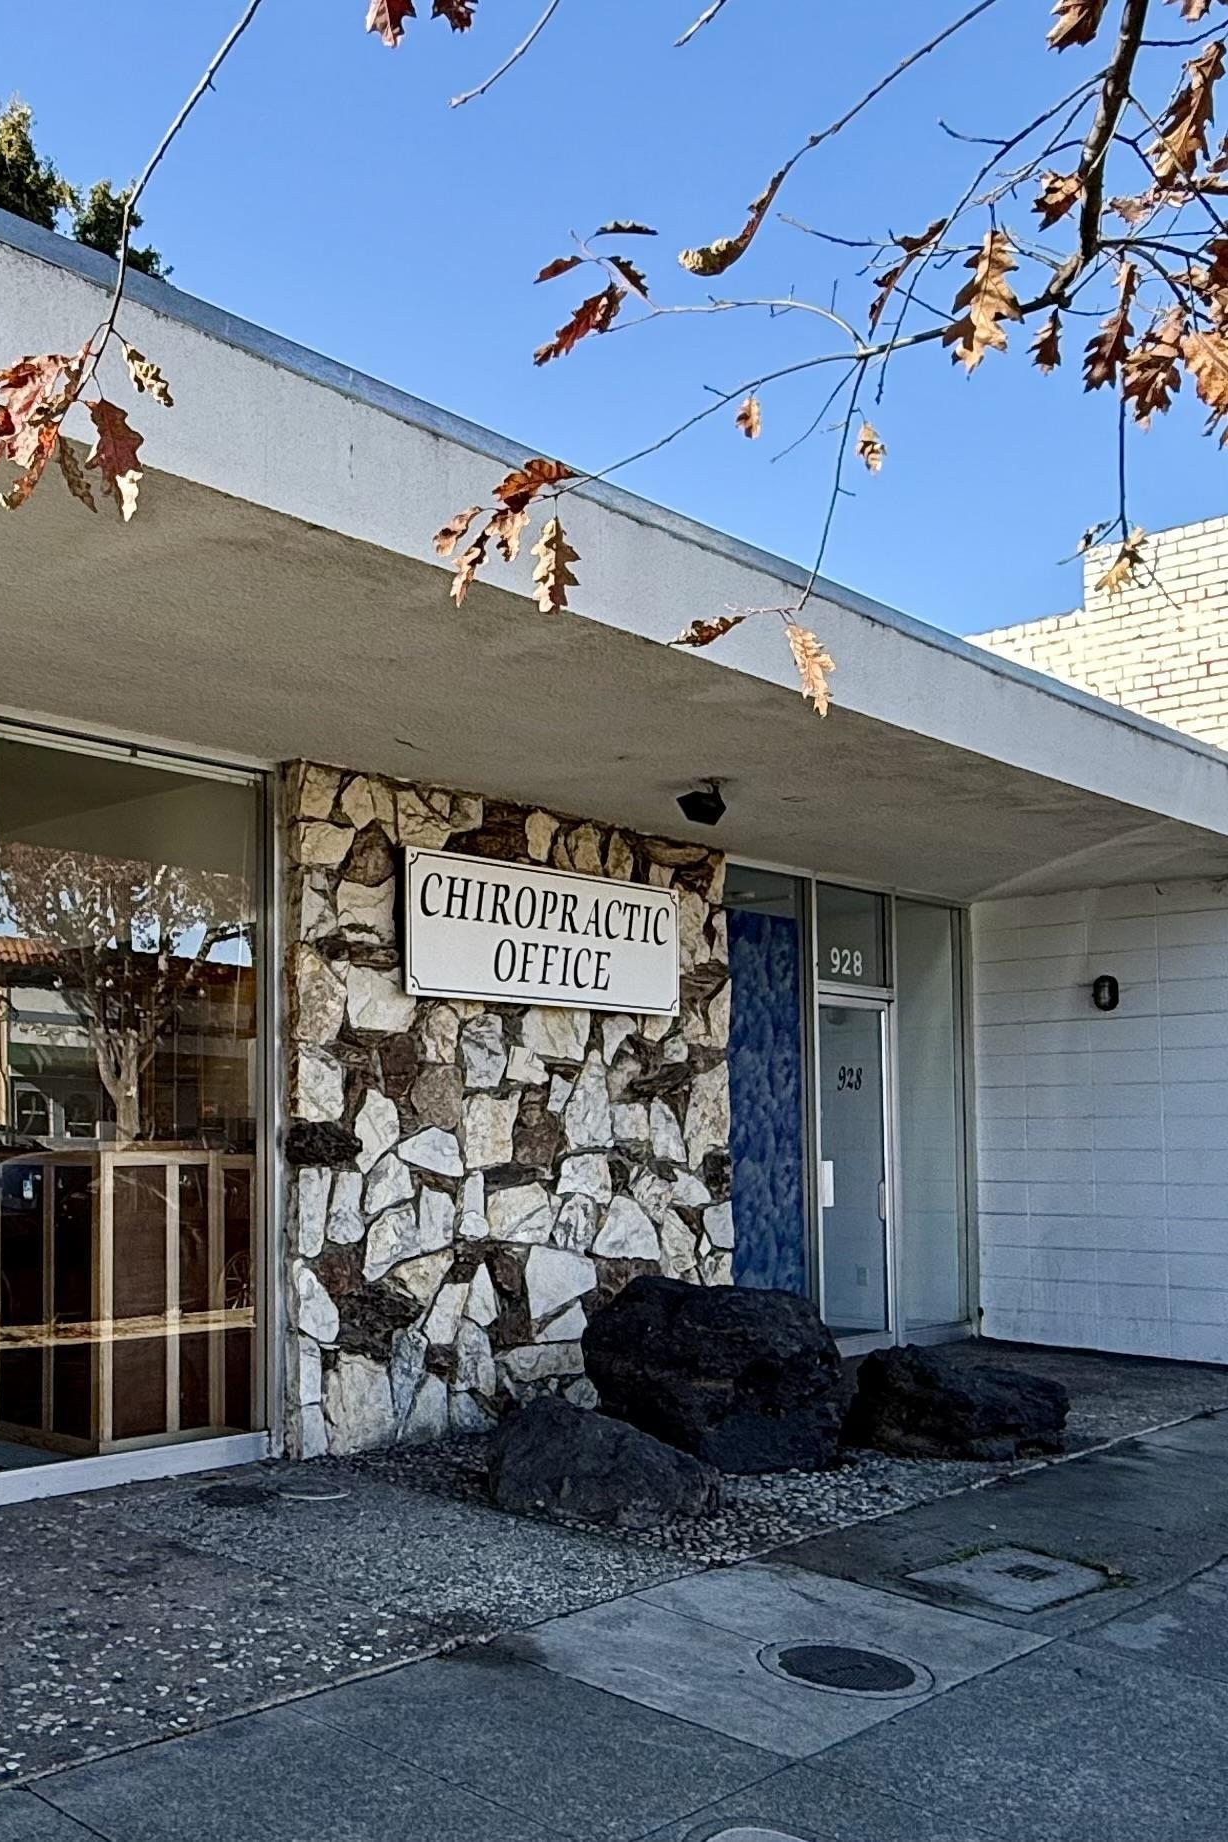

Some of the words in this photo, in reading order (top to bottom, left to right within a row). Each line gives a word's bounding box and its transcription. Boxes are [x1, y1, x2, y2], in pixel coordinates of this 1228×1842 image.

[420, 872, 670, 946] CHIROPRACTIC
[493, 938, 611, 991] OFFICE
[830, 946, 863, 977] 928
[837, 1065, 863, 1091] 928
